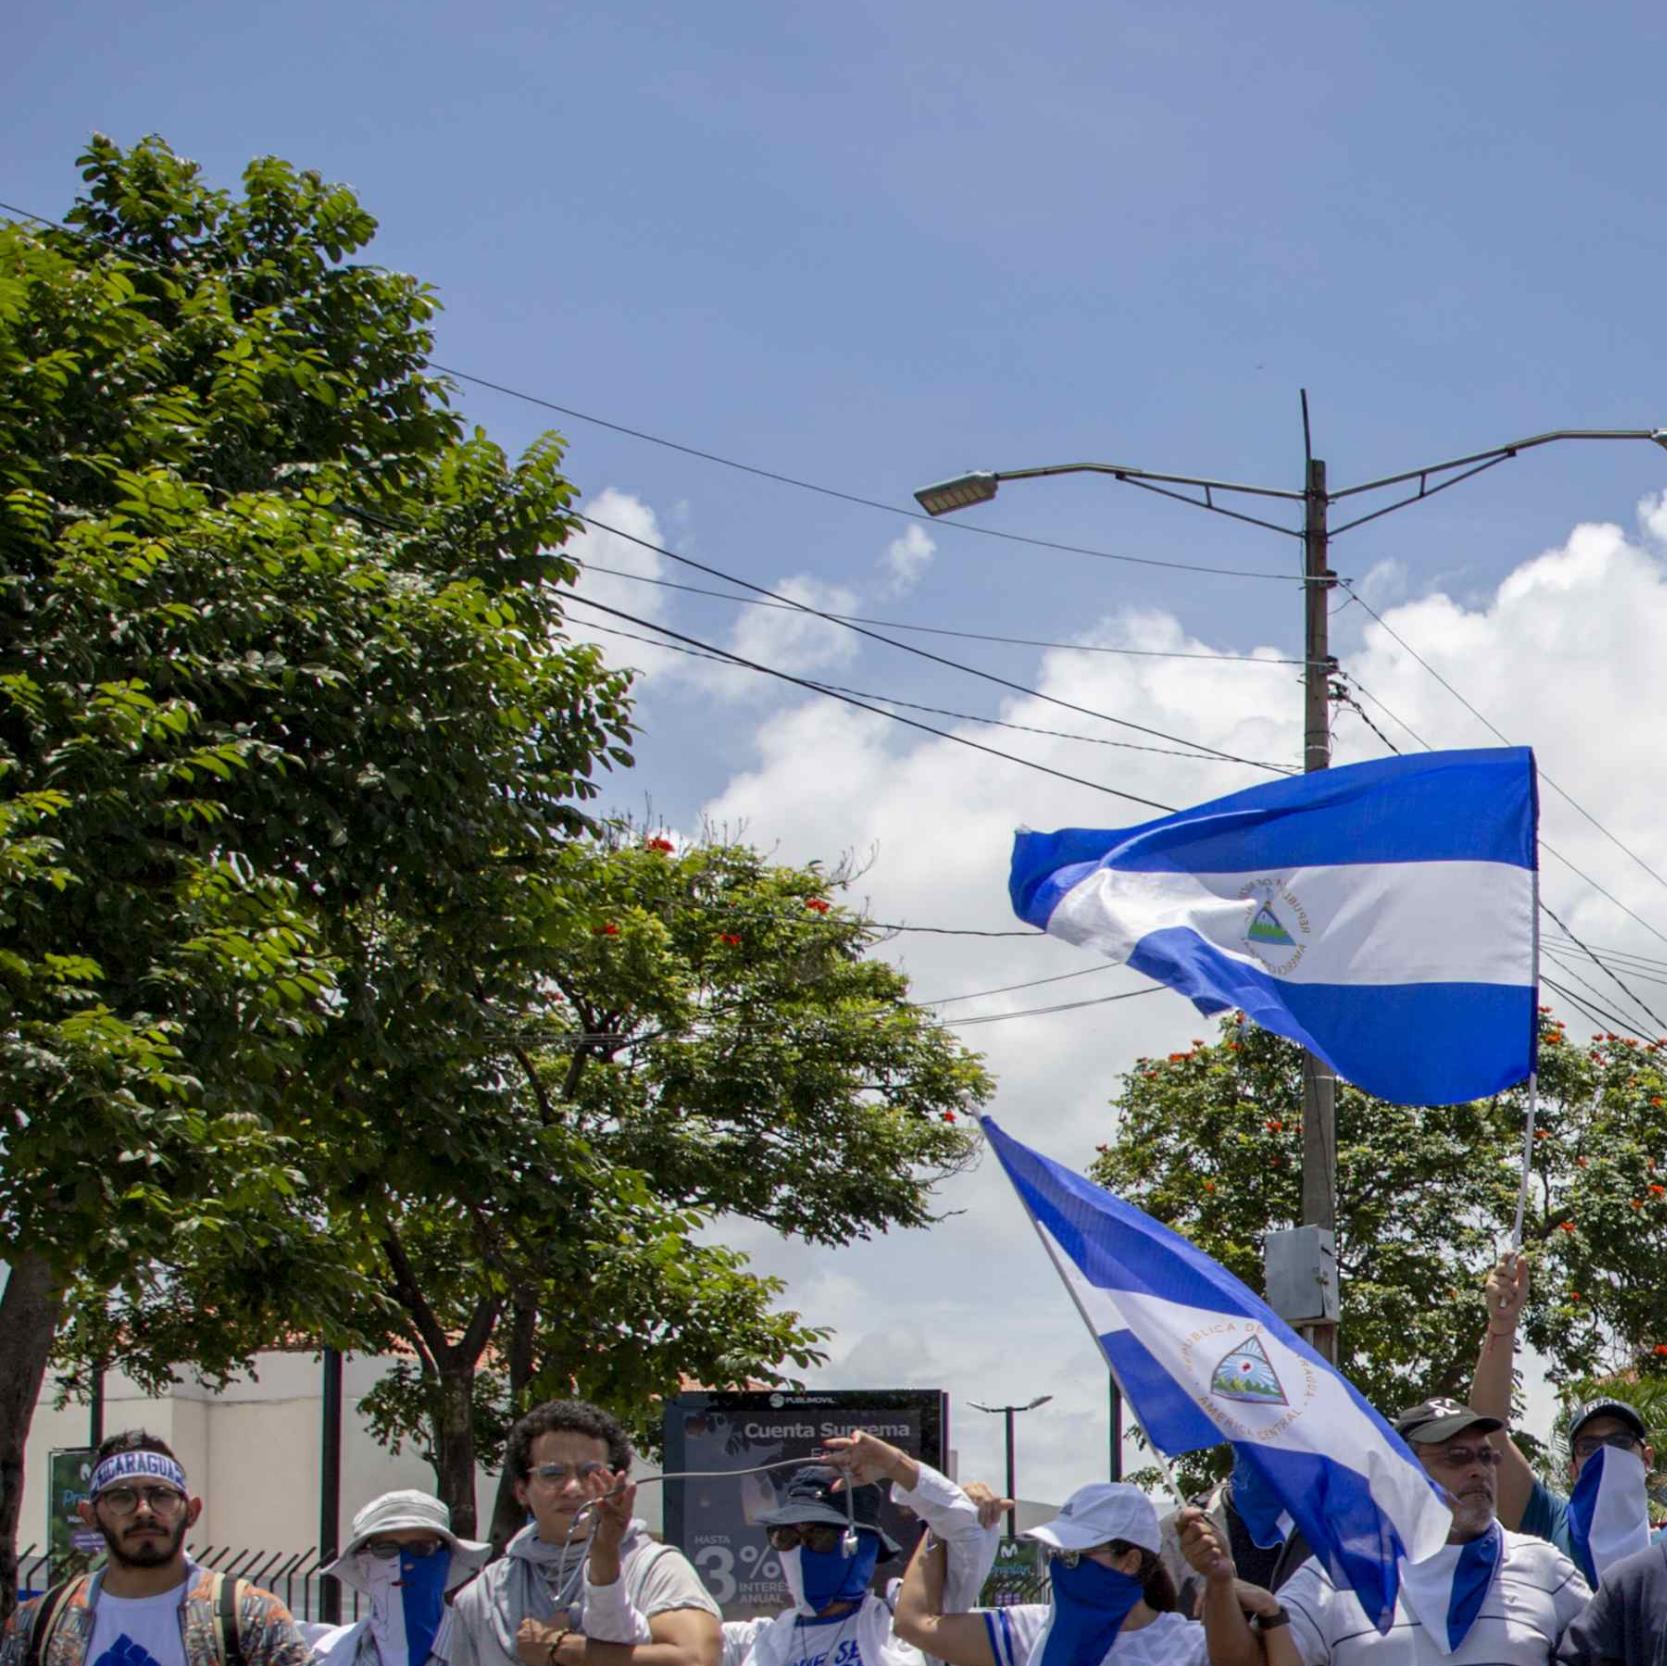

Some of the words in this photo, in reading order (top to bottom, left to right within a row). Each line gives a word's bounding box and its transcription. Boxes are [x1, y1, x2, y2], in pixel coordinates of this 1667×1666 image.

[744, 1420, 815, 1440] Cuenta
[695, 1535, 731, 1545] HASTA
[835, 1640, 861, 1664] SE
